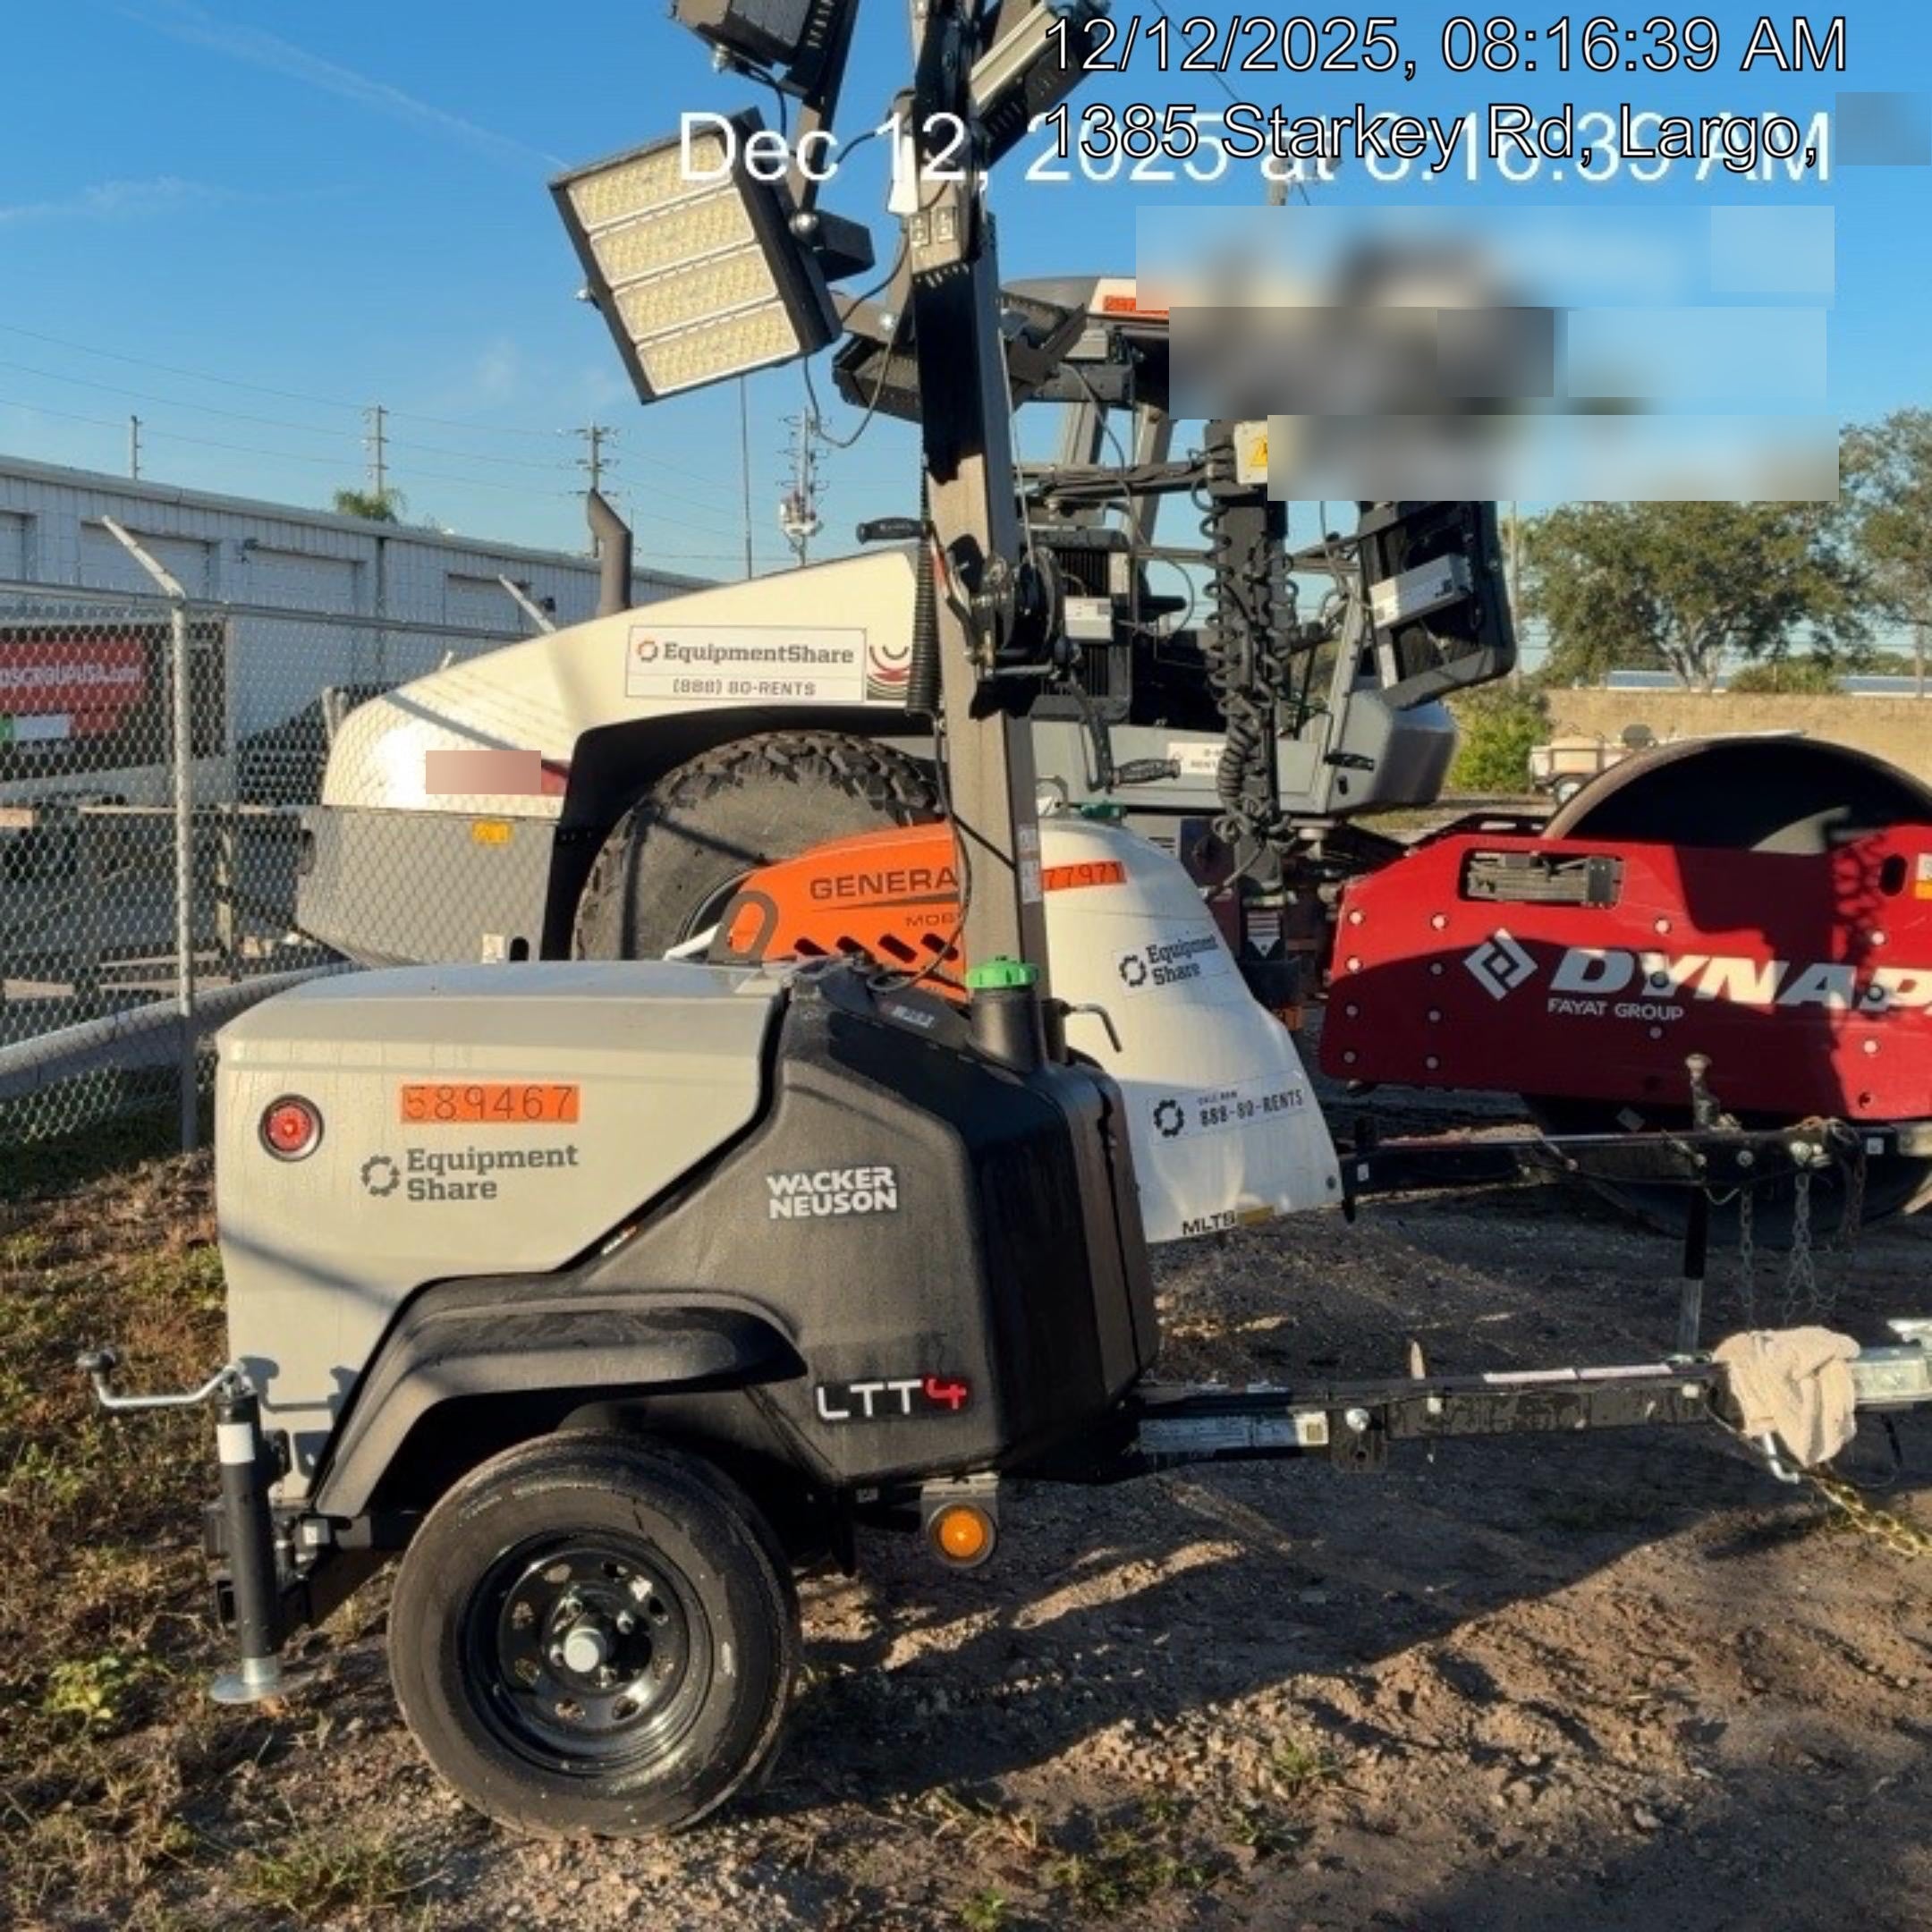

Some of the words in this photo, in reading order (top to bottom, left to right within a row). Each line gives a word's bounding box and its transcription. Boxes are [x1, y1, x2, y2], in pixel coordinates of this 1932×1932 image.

[663, 642, 854, 665] EquipmentShare
[673, 677, 723, 696] (888)
[727, 679, 816, 697] 80-RENTS
[809, 865, 958, 901] GENERA
[906, 911, 959, 928] MOB
[1145, 934, 1218, 964] Equipment
[1151, 962, 1200, 986] Share
[1549, 947, 1932, 1015] DYNAP
[1547, 997, 1608, 1016] FAYAT
[1614, 1002, 1685, 1021] GROUP
[405, 1085, 573, 1120] 589467
[406, 1145, 580, 1176] Equipment
[406, 1177, 498, 1201] Share
[767, 1165, 895, 1197] WACKER
[768, 1187, 898, 1220] NEUSON
[816, 1377, 968, 1420] LTT4
